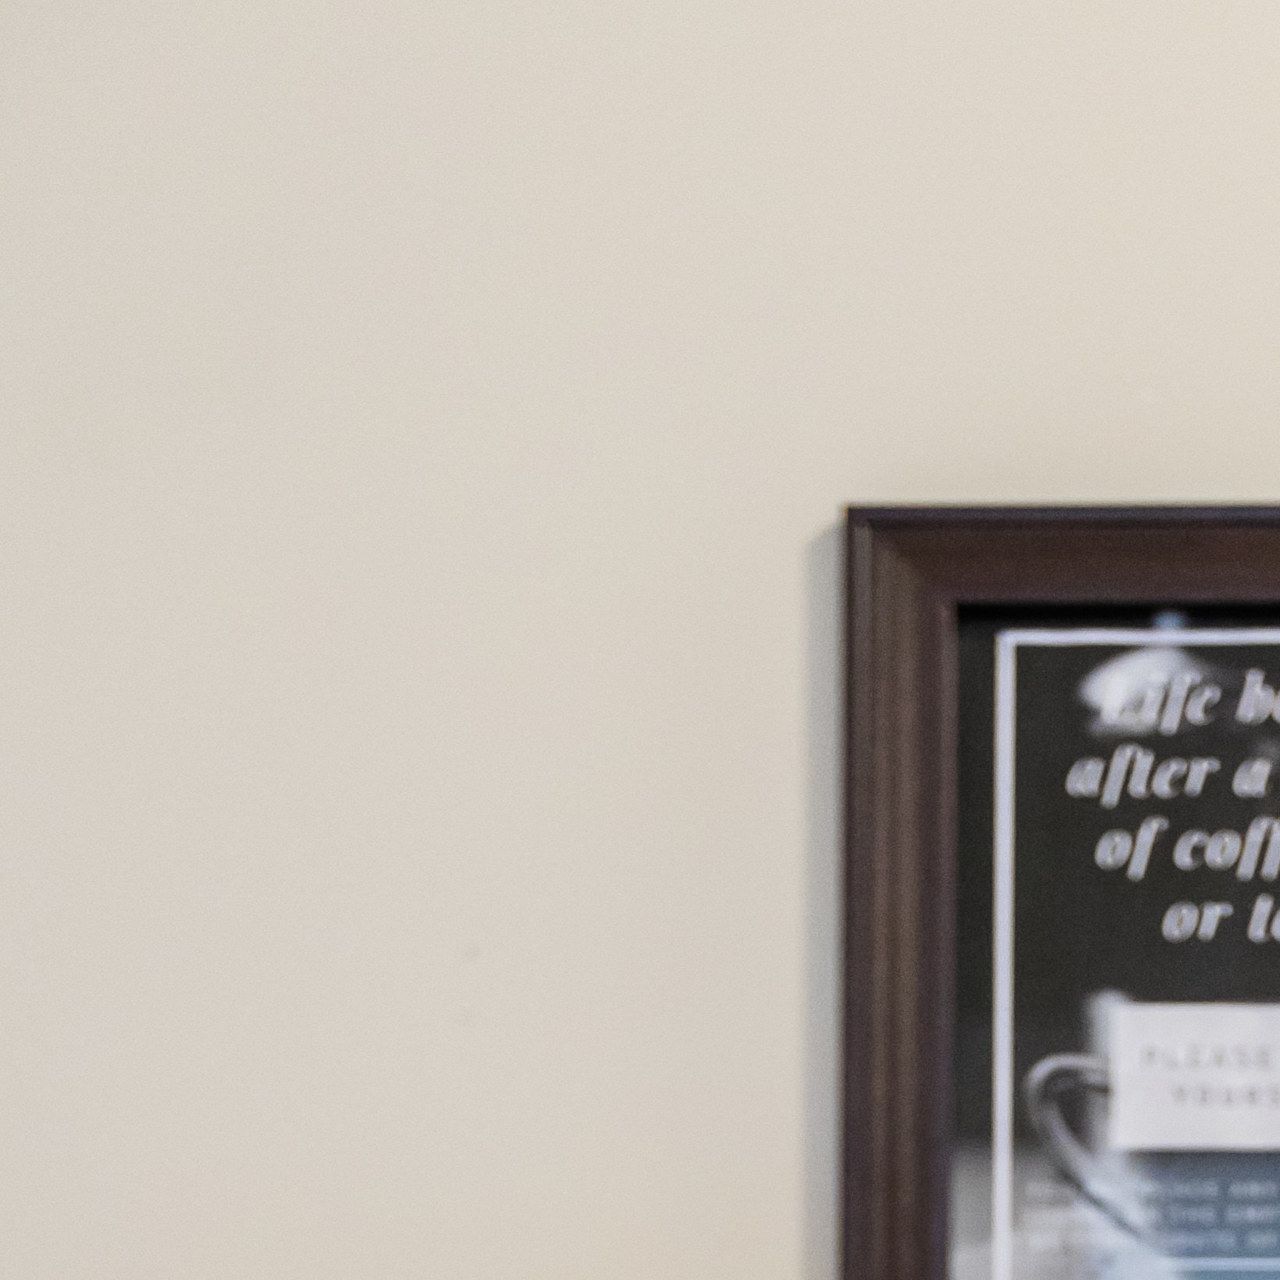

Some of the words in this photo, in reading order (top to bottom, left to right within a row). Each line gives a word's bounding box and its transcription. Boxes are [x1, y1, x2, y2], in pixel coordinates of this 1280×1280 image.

[1065, 744, 1221, 809] after
[1231, 757, 1273, 797] a
[1094, 815, 1168, 881] of
[1160, 901, 1233, 942] or
[1141, 1044, 1271, 1071] PLEASE
